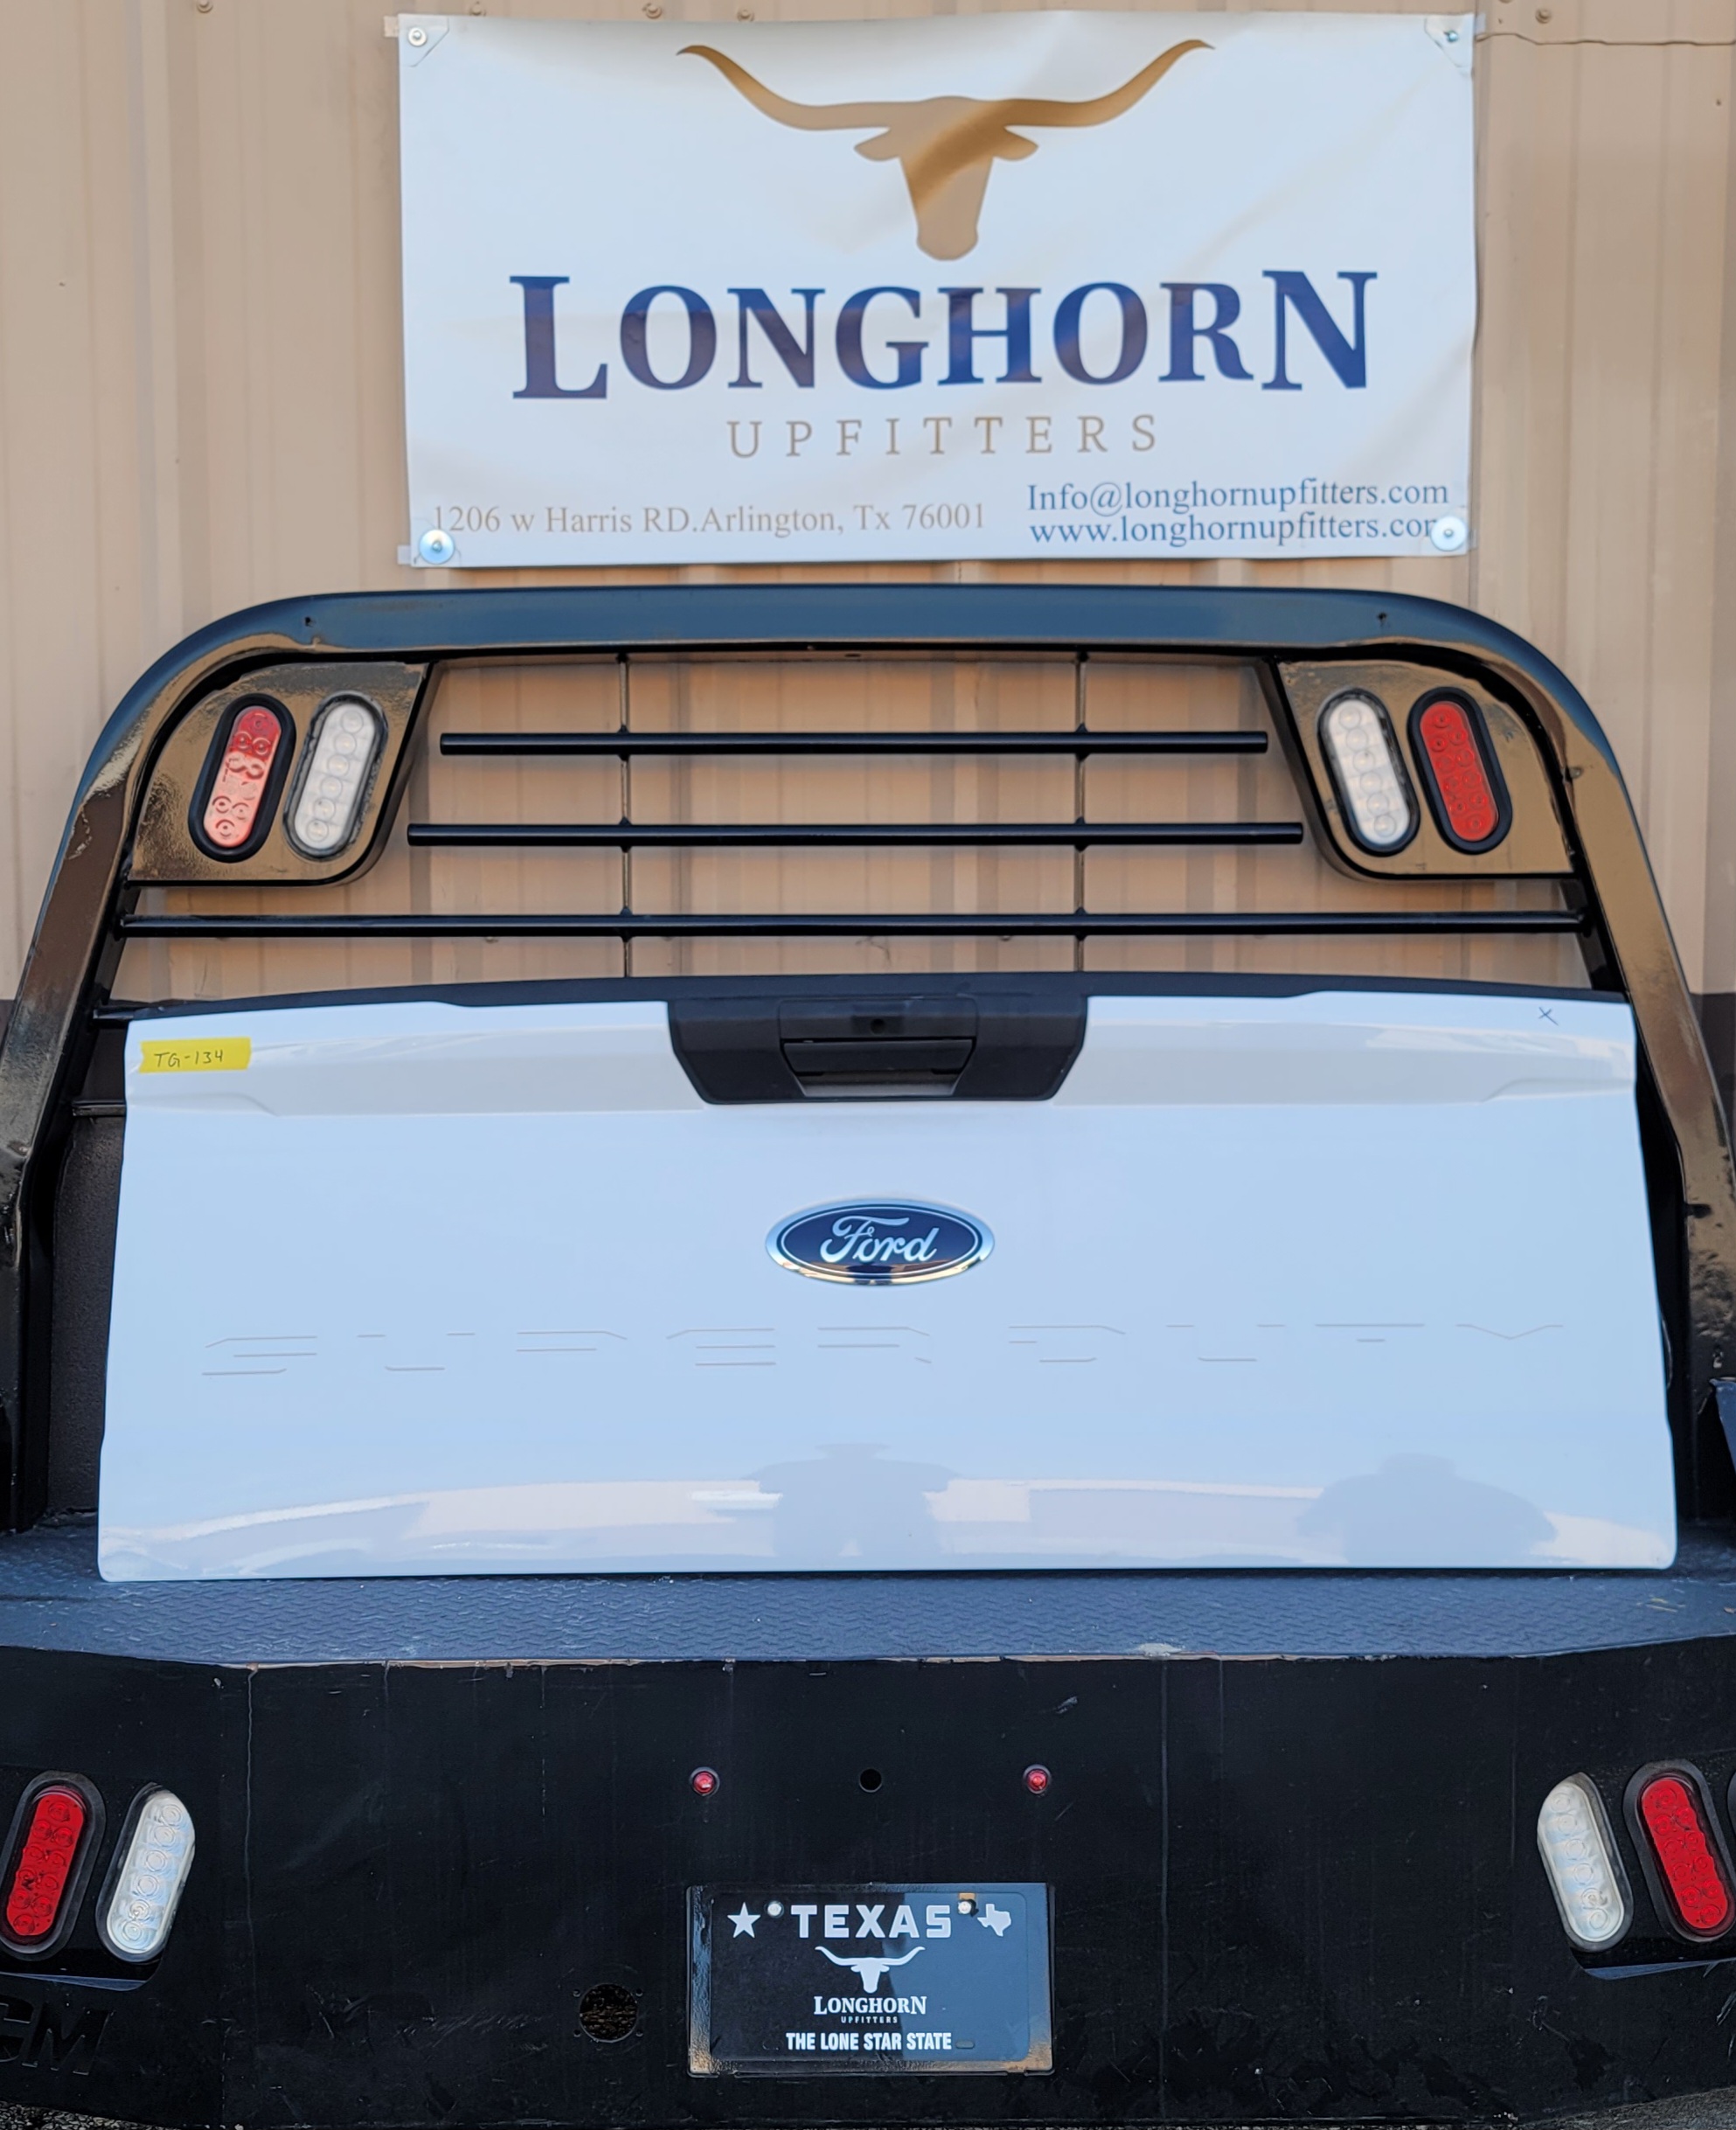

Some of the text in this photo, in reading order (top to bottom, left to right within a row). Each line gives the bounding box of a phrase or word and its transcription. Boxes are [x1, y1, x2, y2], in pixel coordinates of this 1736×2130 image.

[510, 269, 1378, 400] LONGHORN
[727, 413, 1156, 459] UPFITTERS
[1027, 477, 1450, 517] Info@longhornupfitters.com
[434, 504, 501, 532] 1206
[510, 513, 535, 532] w
[544, 505, 633, 533] Harris
[853, 504, 892, 531] Tx
[901, 503, 985, 531] 76001
[153, 1049, 225, 1069] TG-134
[819, 1215, 941, 1264] Ford
[790, 1904, 952, 1939] TEXAS
[813, 1995, 927, 2015] LONGHORN
[840, 2015, 899, 2024] UPFITTERS
[786, 2032, 952, 2050] THE LONE STAR STATE
